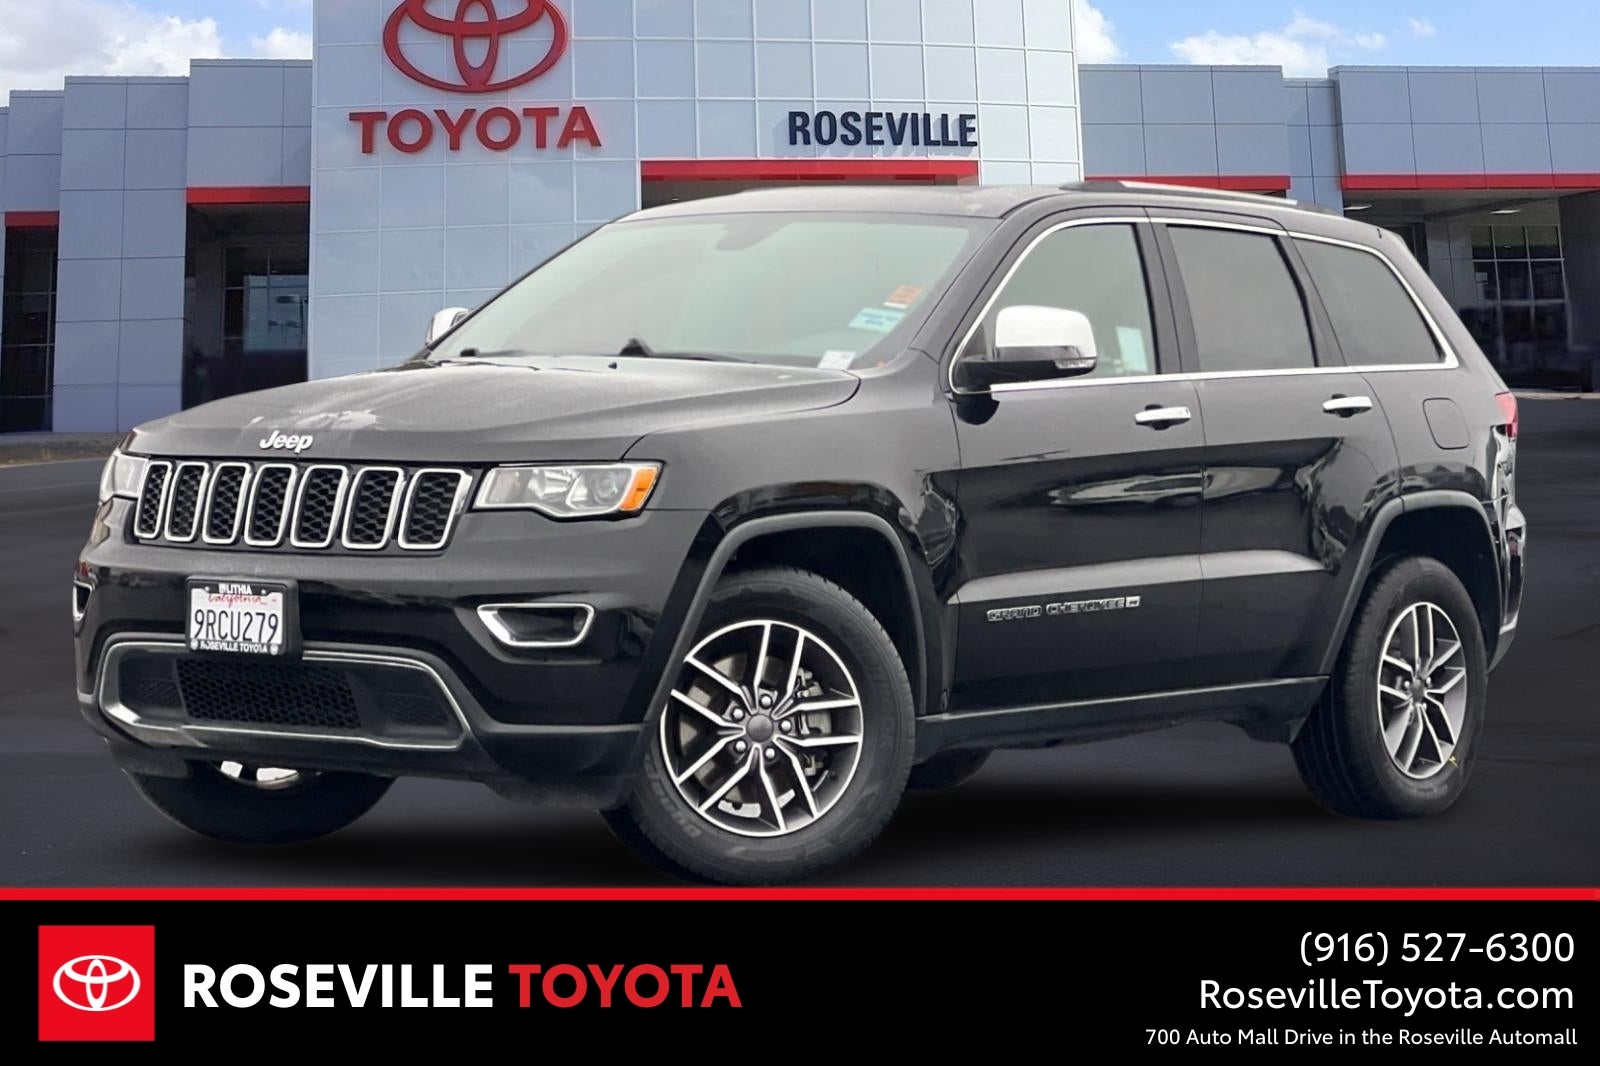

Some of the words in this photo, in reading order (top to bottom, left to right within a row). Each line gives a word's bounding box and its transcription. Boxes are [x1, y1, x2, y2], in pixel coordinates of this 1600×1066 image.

[349, 106, 602, 154] TOYOTA
[788, 111, 978, 147] ROSEVILLE
[259, 430, 313, 454] Jeep
[194, 609, 279, 643] 9RCU279
[986, 605, 1042, 622] GRAND
[240, 643, 268, 653] TOYOTA
